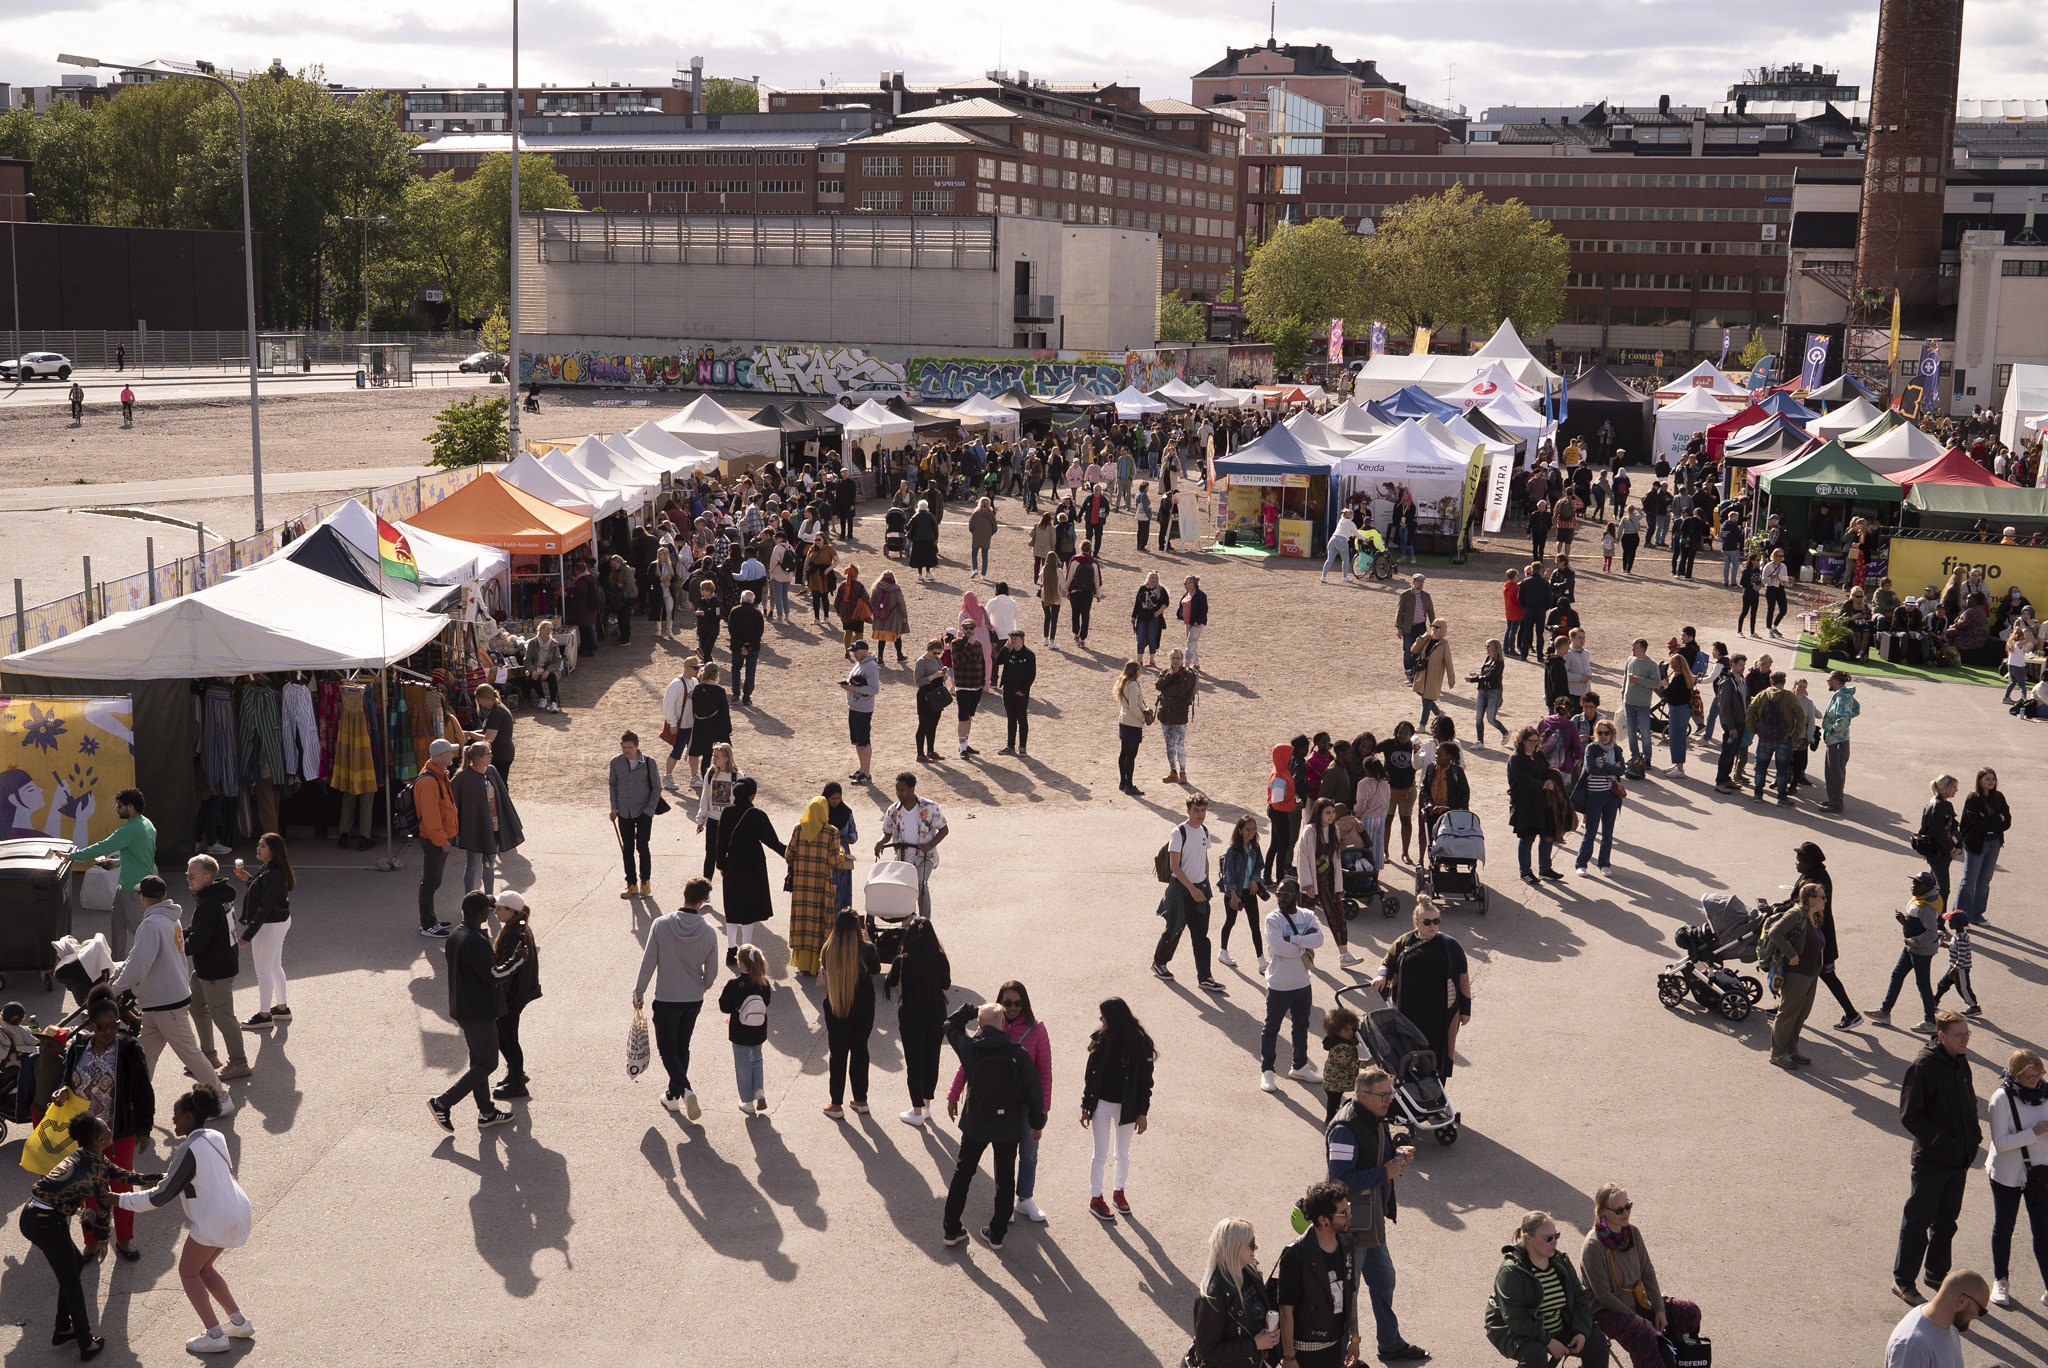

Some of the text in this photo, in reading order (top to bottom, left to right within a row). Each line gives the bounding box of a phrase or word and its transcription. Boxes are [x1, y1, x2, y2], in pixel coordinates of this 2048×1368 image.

[1357, 463, 1385, 472] Keuda
[1493, 465, 1508, 506] IMATRA
[1832, 486, 1858, 496] ADRA
